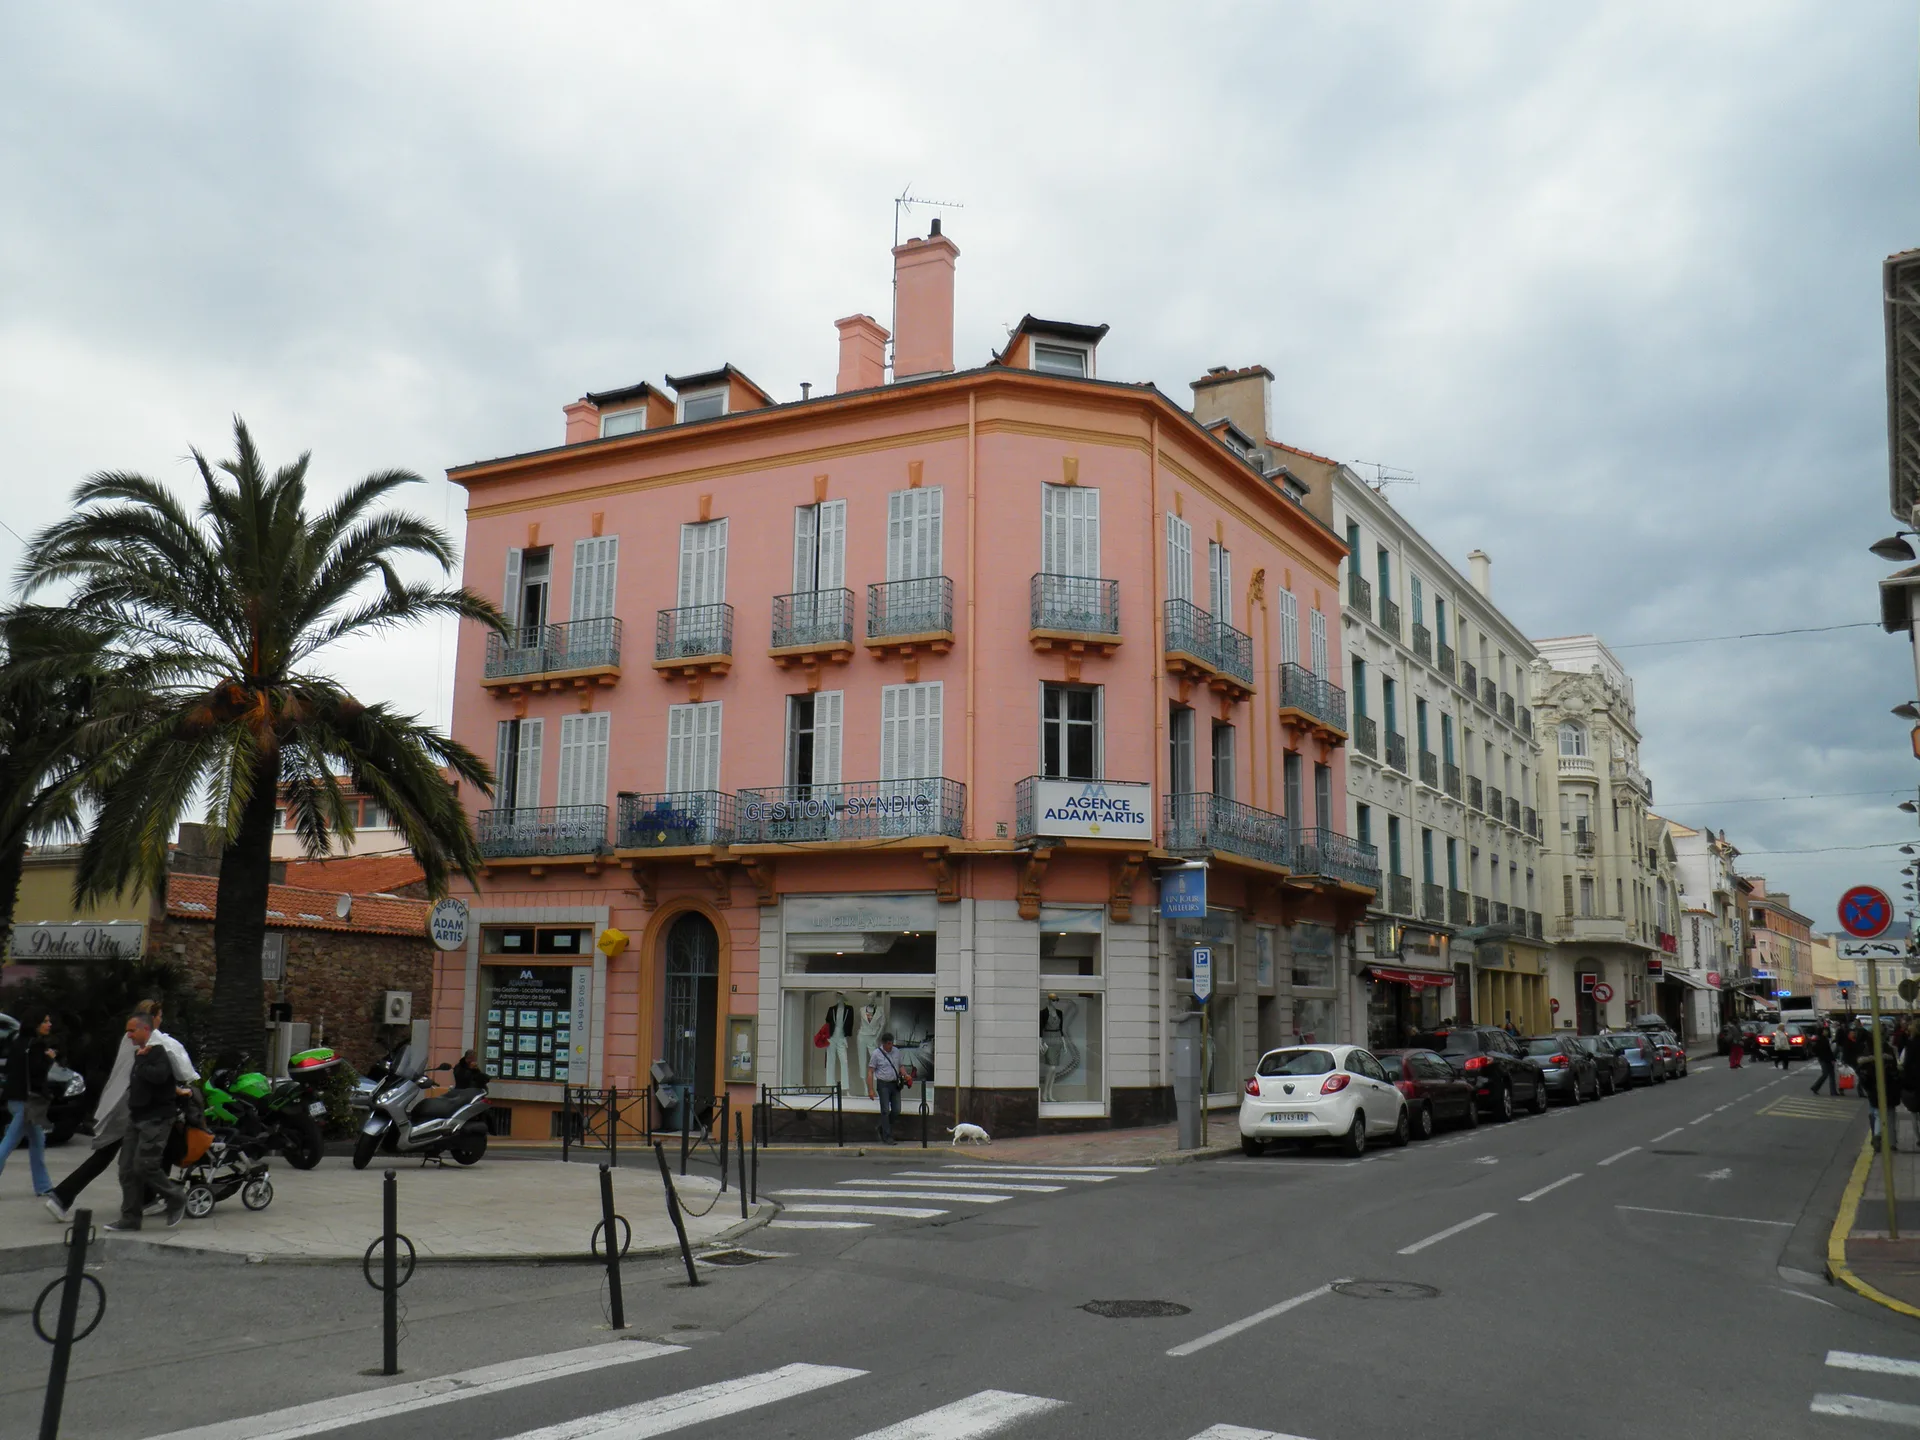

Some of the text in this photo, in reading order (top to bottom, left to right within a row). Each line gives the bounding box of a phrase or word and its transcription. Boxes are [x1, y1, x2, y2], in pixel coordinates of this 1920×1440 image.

[745, 794, 928, 821] GESTION SYNDIC
[1065, 796, 1130, 811] AGENCE
[1044, 808, 1145, 824] ADAM-ARTIS
[482, 821, 589, 840] TRANSACTIONS
[1165, 895, 1199, 904] UN JOUR
[435, 900, 466, 919] AGENCE
[1166, 904, 1200, 912] AILLEURS
[433, 918, 464, 930] ADAM
[812, 915, 829, 928] UN
[830, 915, 855, 928] JOUR
[29, 928, 121, 954] Dolce Vita
[435, 930, 463, 942] ARTIS
[1691, 917, 1700, 969] MONOPRIX
[1198, 952, 1206, 963] P
[577, 974, 586, 1031] 04 94 95 05 01
